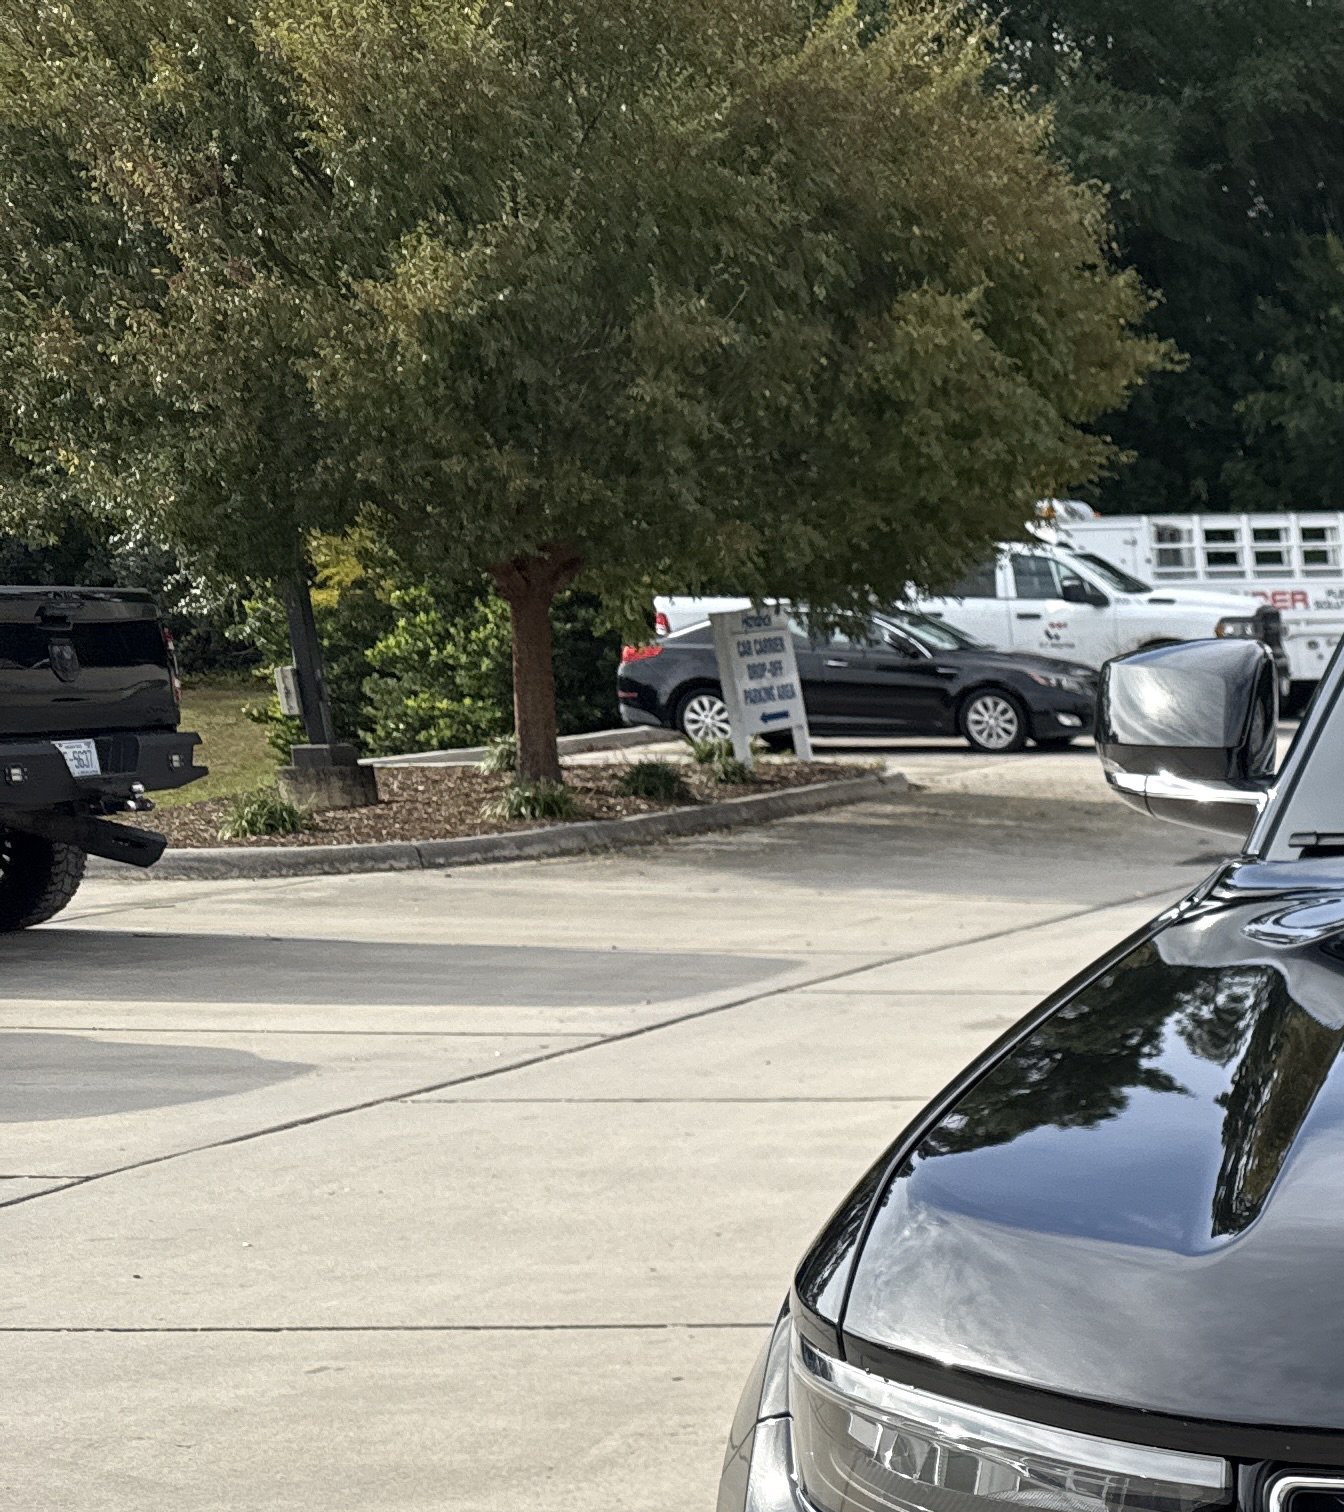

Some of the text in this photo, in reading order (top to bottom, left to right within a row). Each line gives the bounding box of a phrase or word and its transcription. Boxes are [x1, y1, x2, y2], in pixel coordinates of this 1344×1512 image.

[737, 636, 785, 657] CAR CARRIER
[747, 660, 783, 680] DROP-OFF
[744, 683, 797, 705] PARKING AREA
